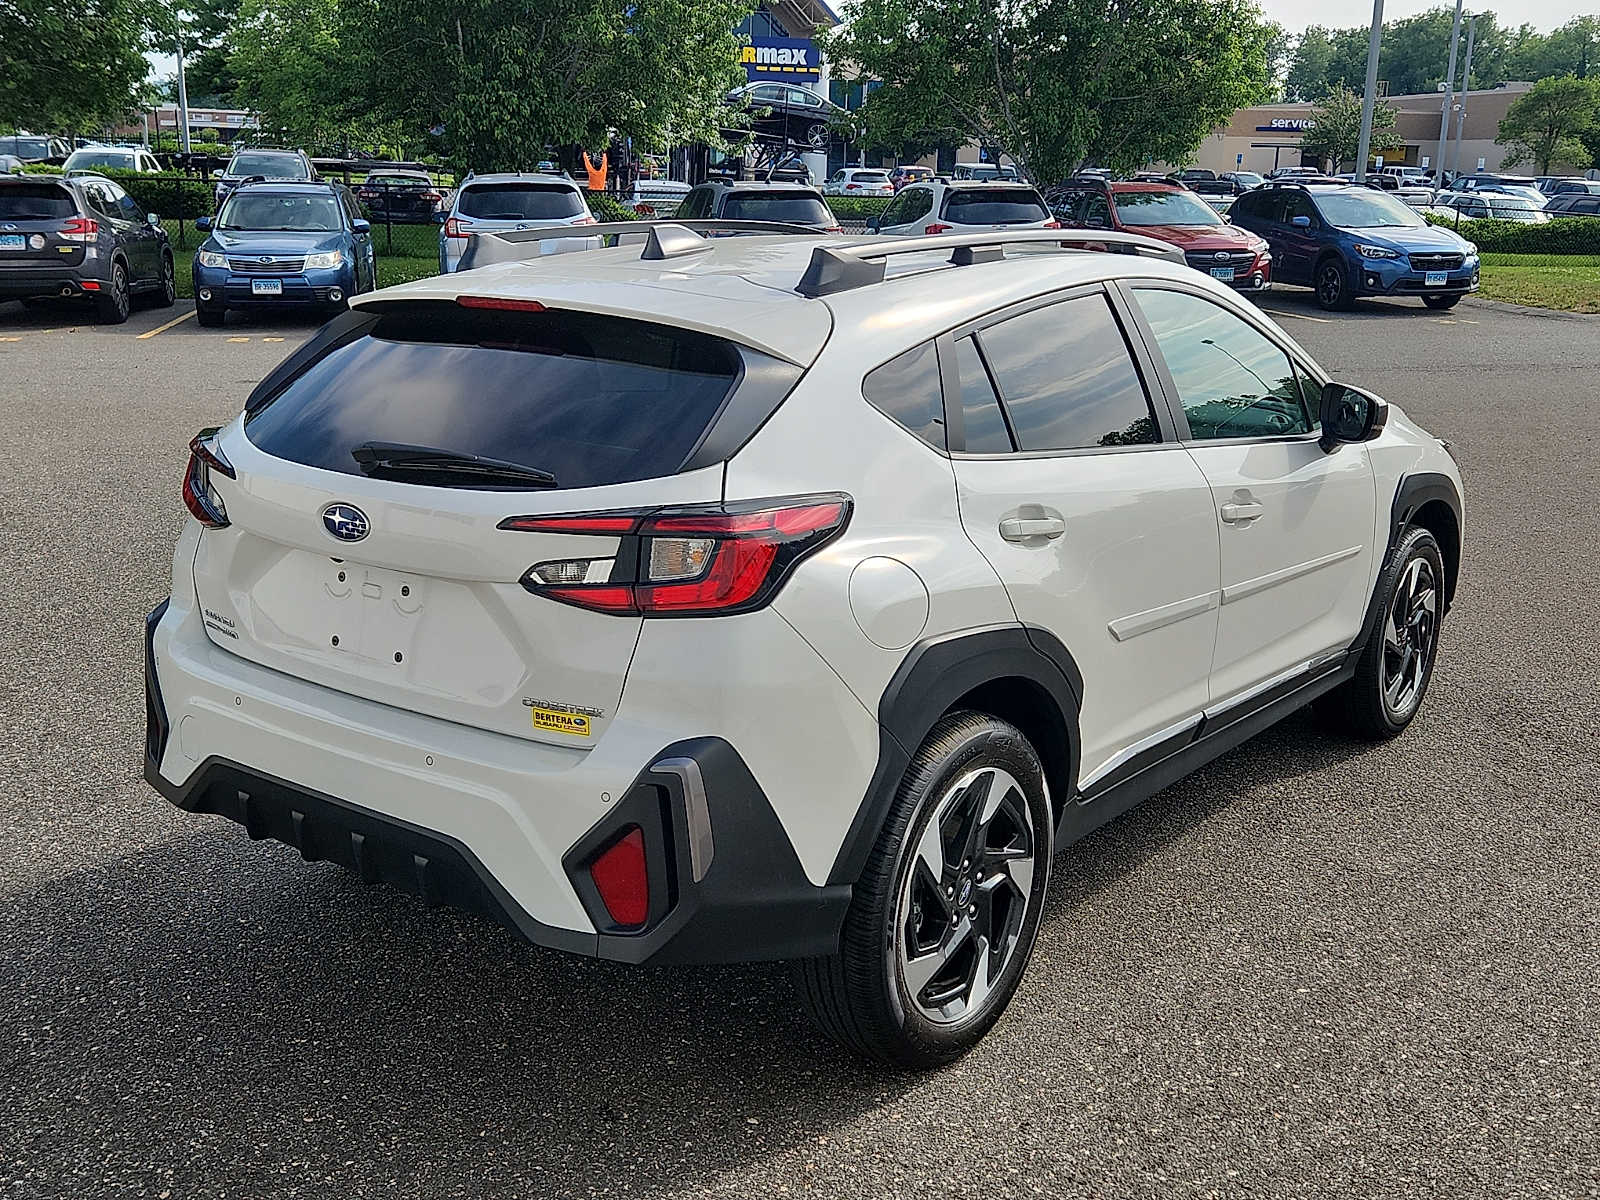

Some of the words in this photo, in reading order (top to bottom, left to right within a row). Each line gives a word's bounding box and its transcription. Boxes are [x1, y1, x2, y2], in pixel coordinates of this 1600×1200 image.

[738, 46, 807, 65] Rmax
[1271, 118, 1316, 129] service
[522, 697, 605, 718] CROSSTREK
[535, 711, 573, 726] BERTERA
